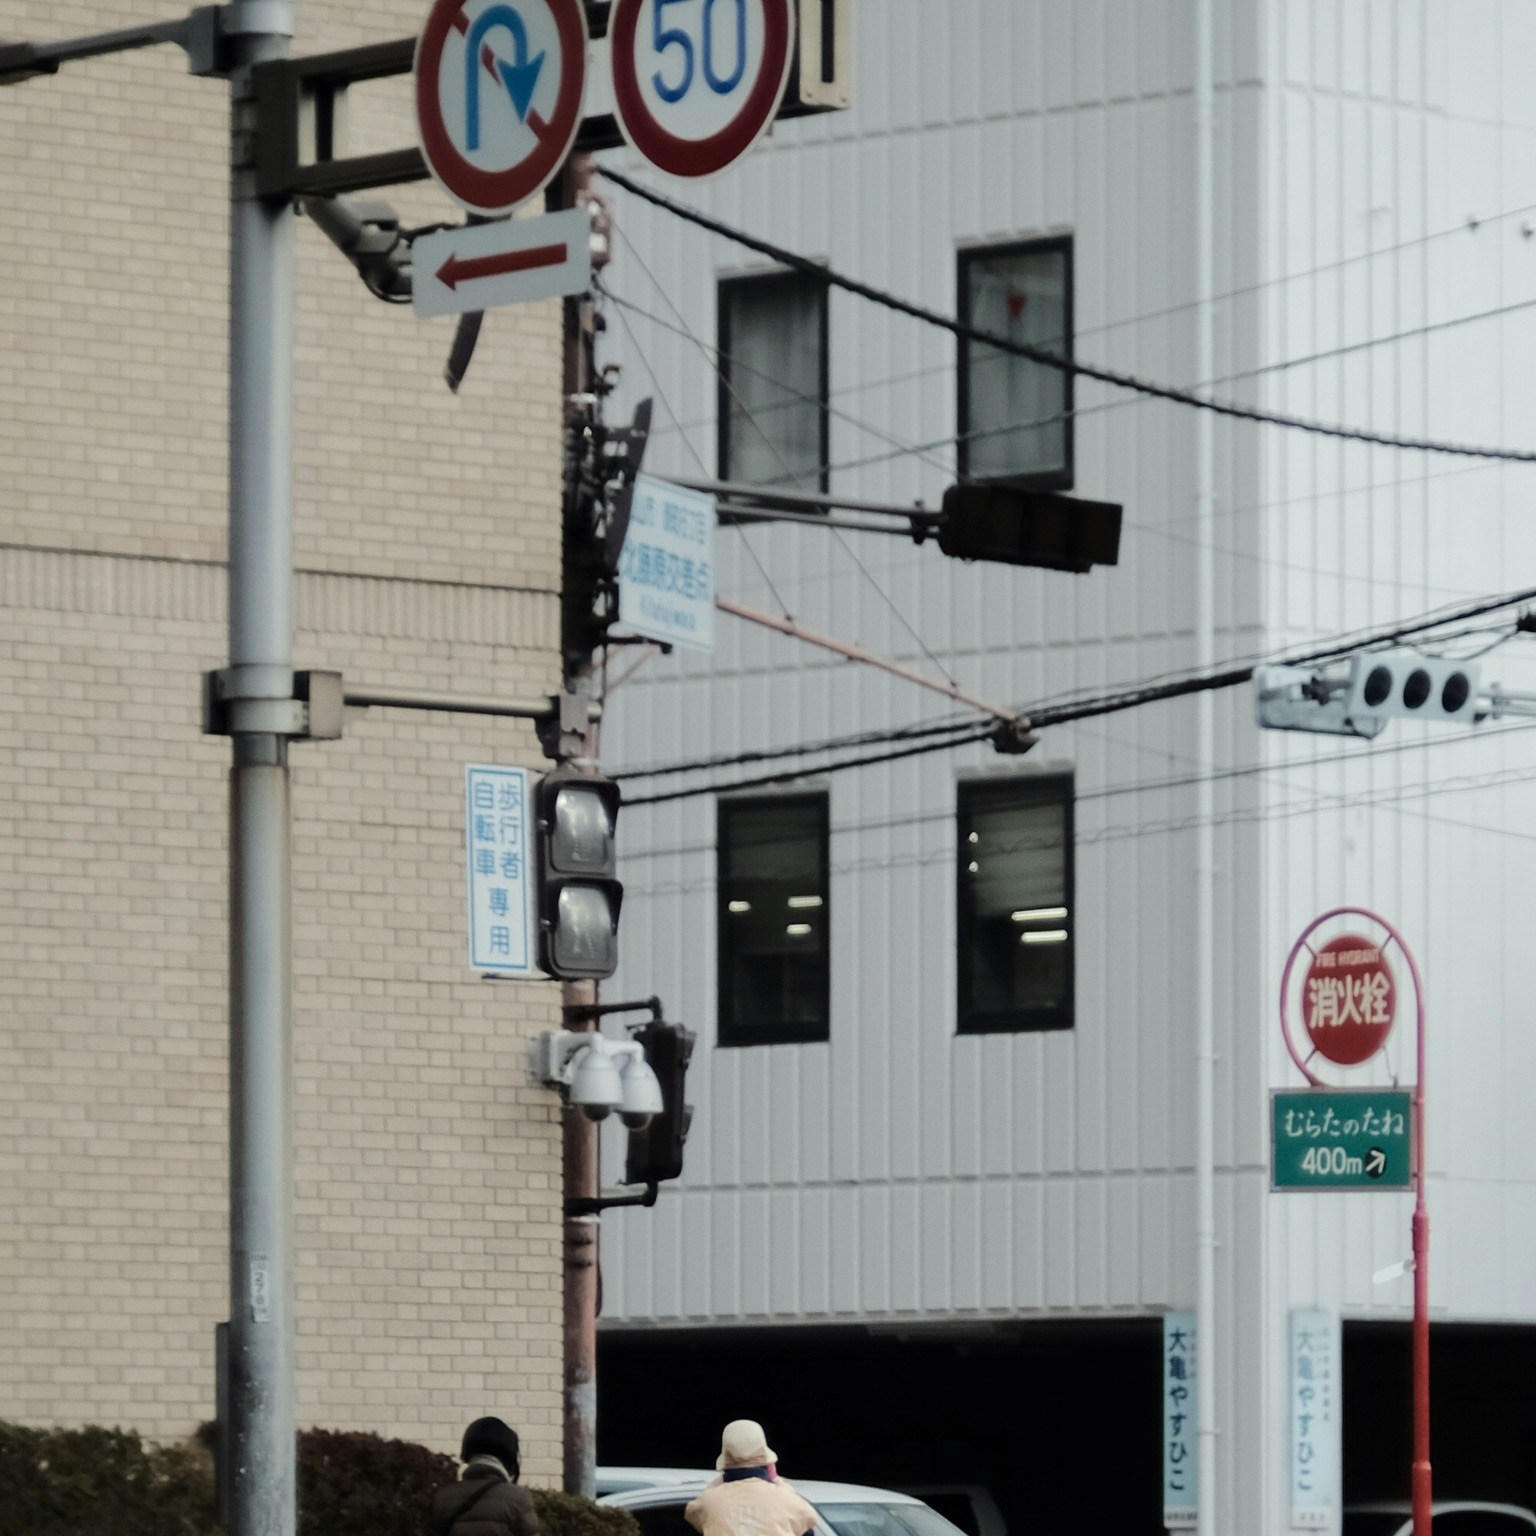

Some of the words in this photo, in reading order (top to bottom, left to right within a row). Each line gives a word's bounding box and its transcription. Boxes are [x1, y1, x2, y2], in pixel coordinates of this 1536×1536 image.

[651, 0, 746, 103] 50
[474, 780, 497, 877] 自転車
[498, 782, 521, 880] 歩行者
[488, 887, 510, 956] 専用
[1309, 971, 1390, 1029] 消火栓
[1286, 1108, 1404, 1138] むらたのたね
[1303, 1147, 1362, 1175] 400m
